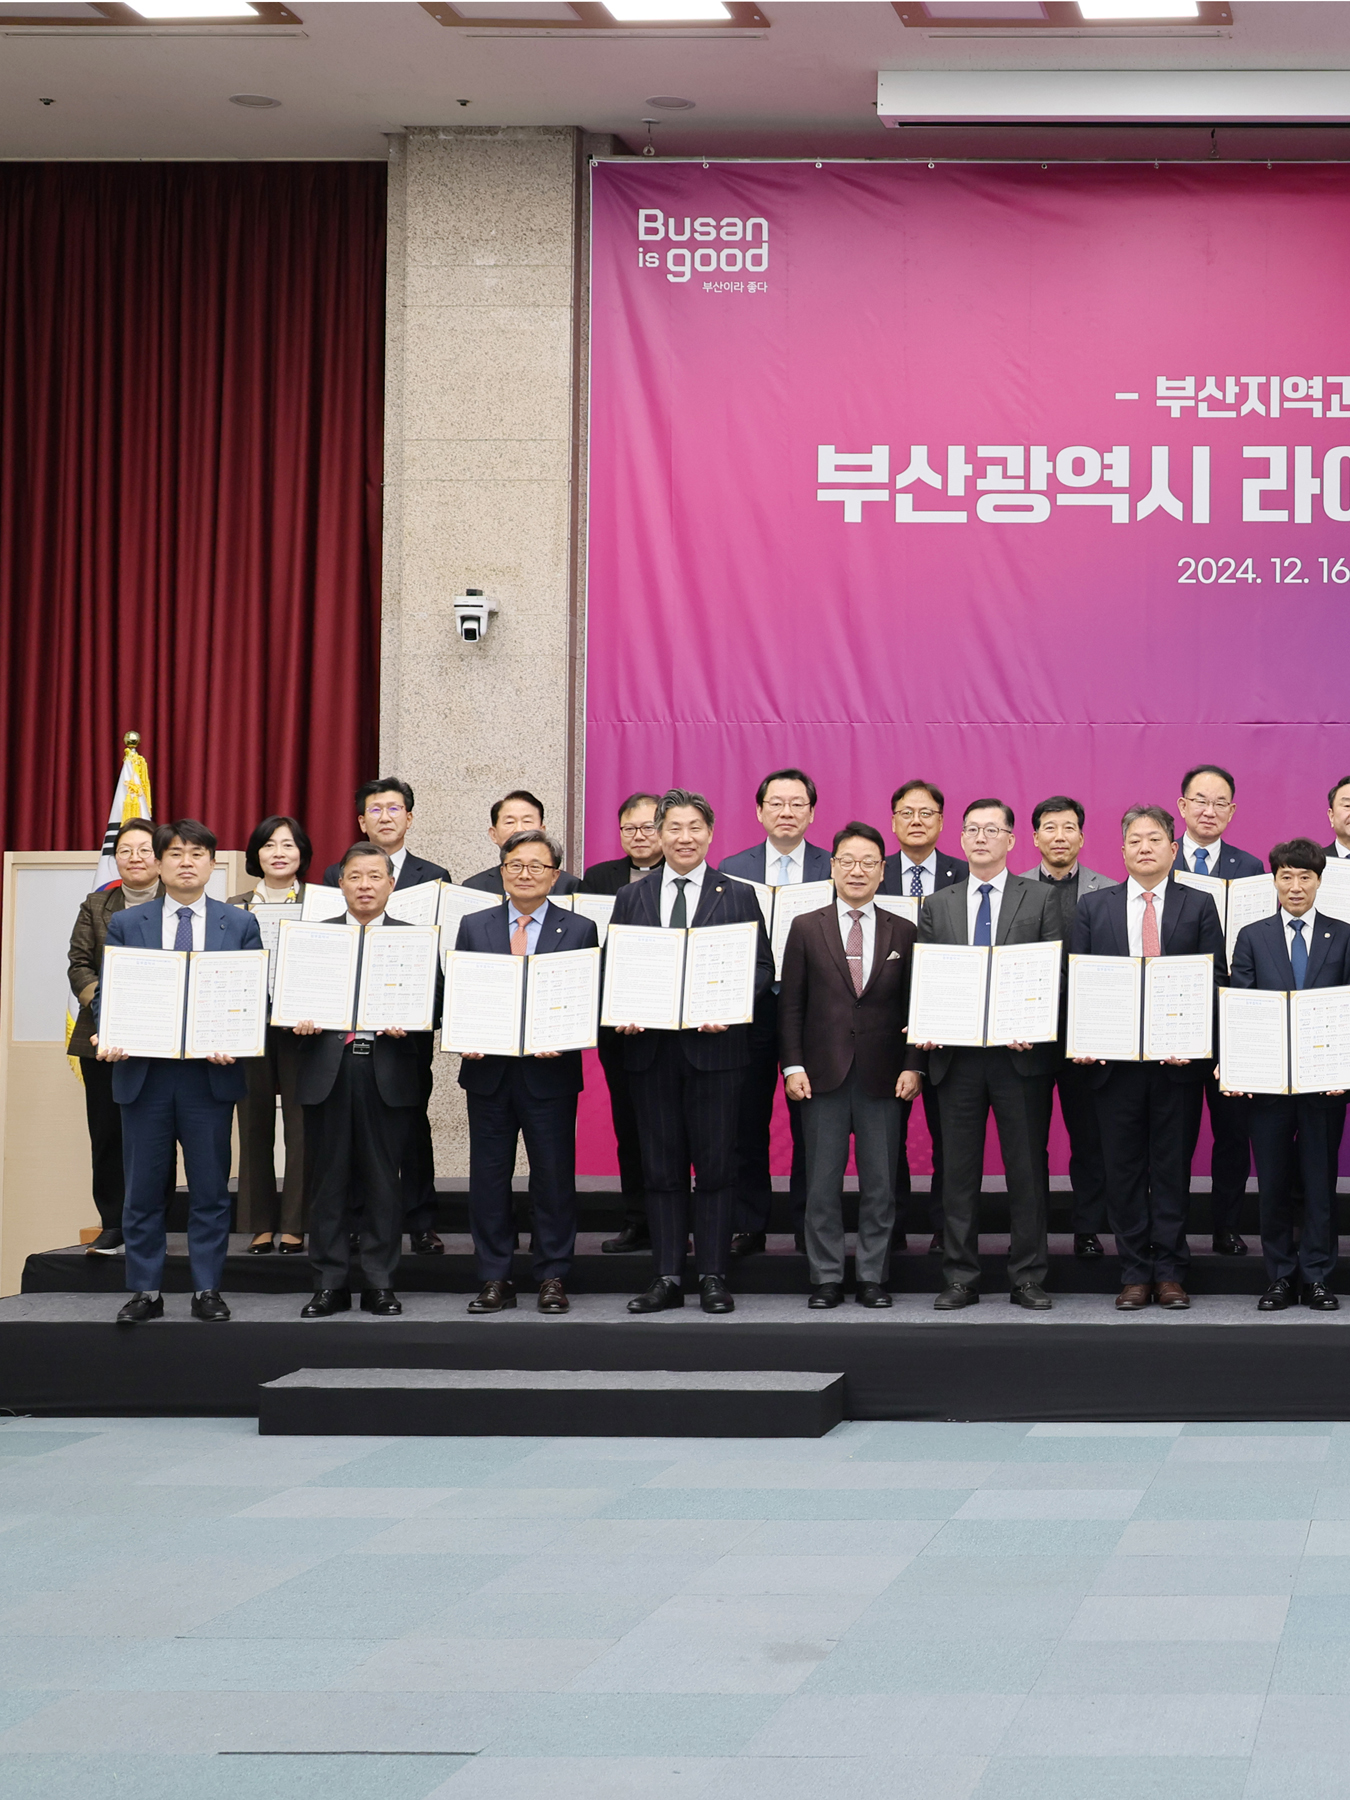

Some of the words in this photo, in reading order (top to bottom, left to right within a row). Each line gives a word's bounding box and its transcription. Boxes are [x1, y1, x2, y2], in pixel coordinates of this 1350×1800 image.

[638, 209, 769, 241] Busan
[638, 247, 660, 268] is
[666, 242, 769, 283] good
[702, 281, 745, 293] 부산이라
[746, 281, 768, 294] 좋다
[816, 444, 1210, 524] 부산광역시
[1177, 557, 1262, 584] 2024.
[1270, 557, 1310, 584] 12.
